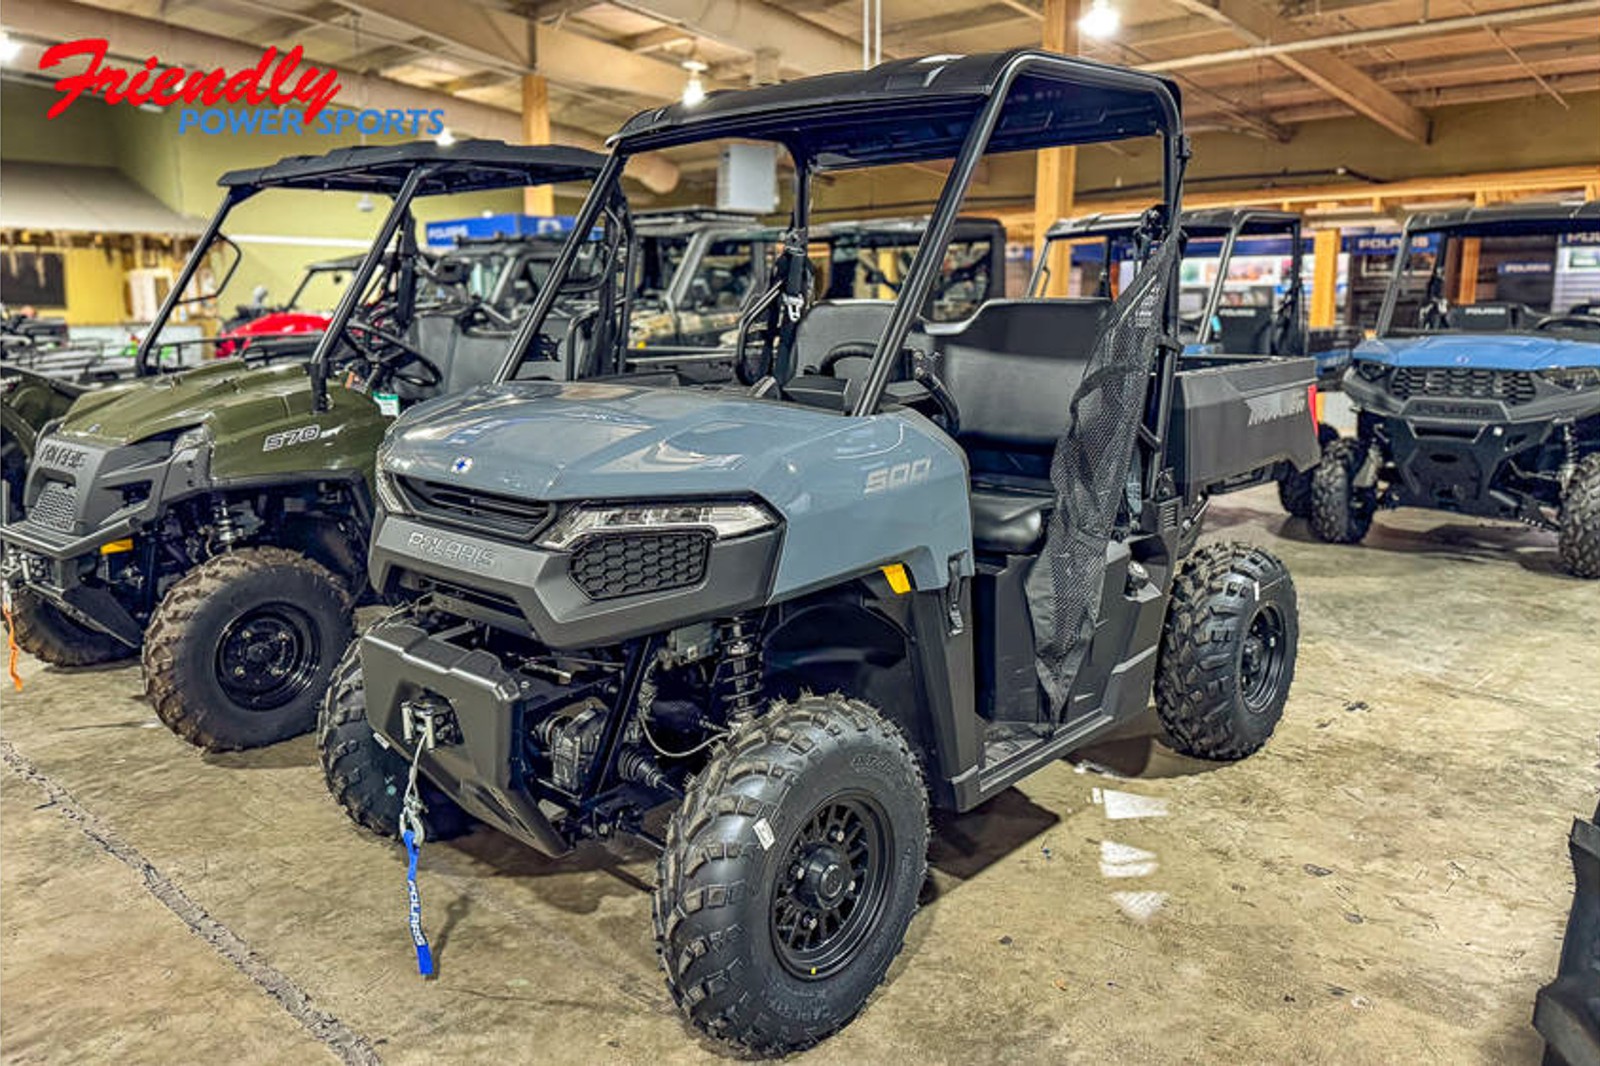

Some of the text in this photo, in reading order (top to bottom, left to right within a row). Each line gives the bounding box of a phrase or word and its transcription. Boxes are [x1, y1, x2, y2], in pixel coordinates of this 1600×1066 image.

[262, 424, 321, 452] 570
[864, 456, 933, 496] 500
[407, 531, 496, 567] POLARIS
